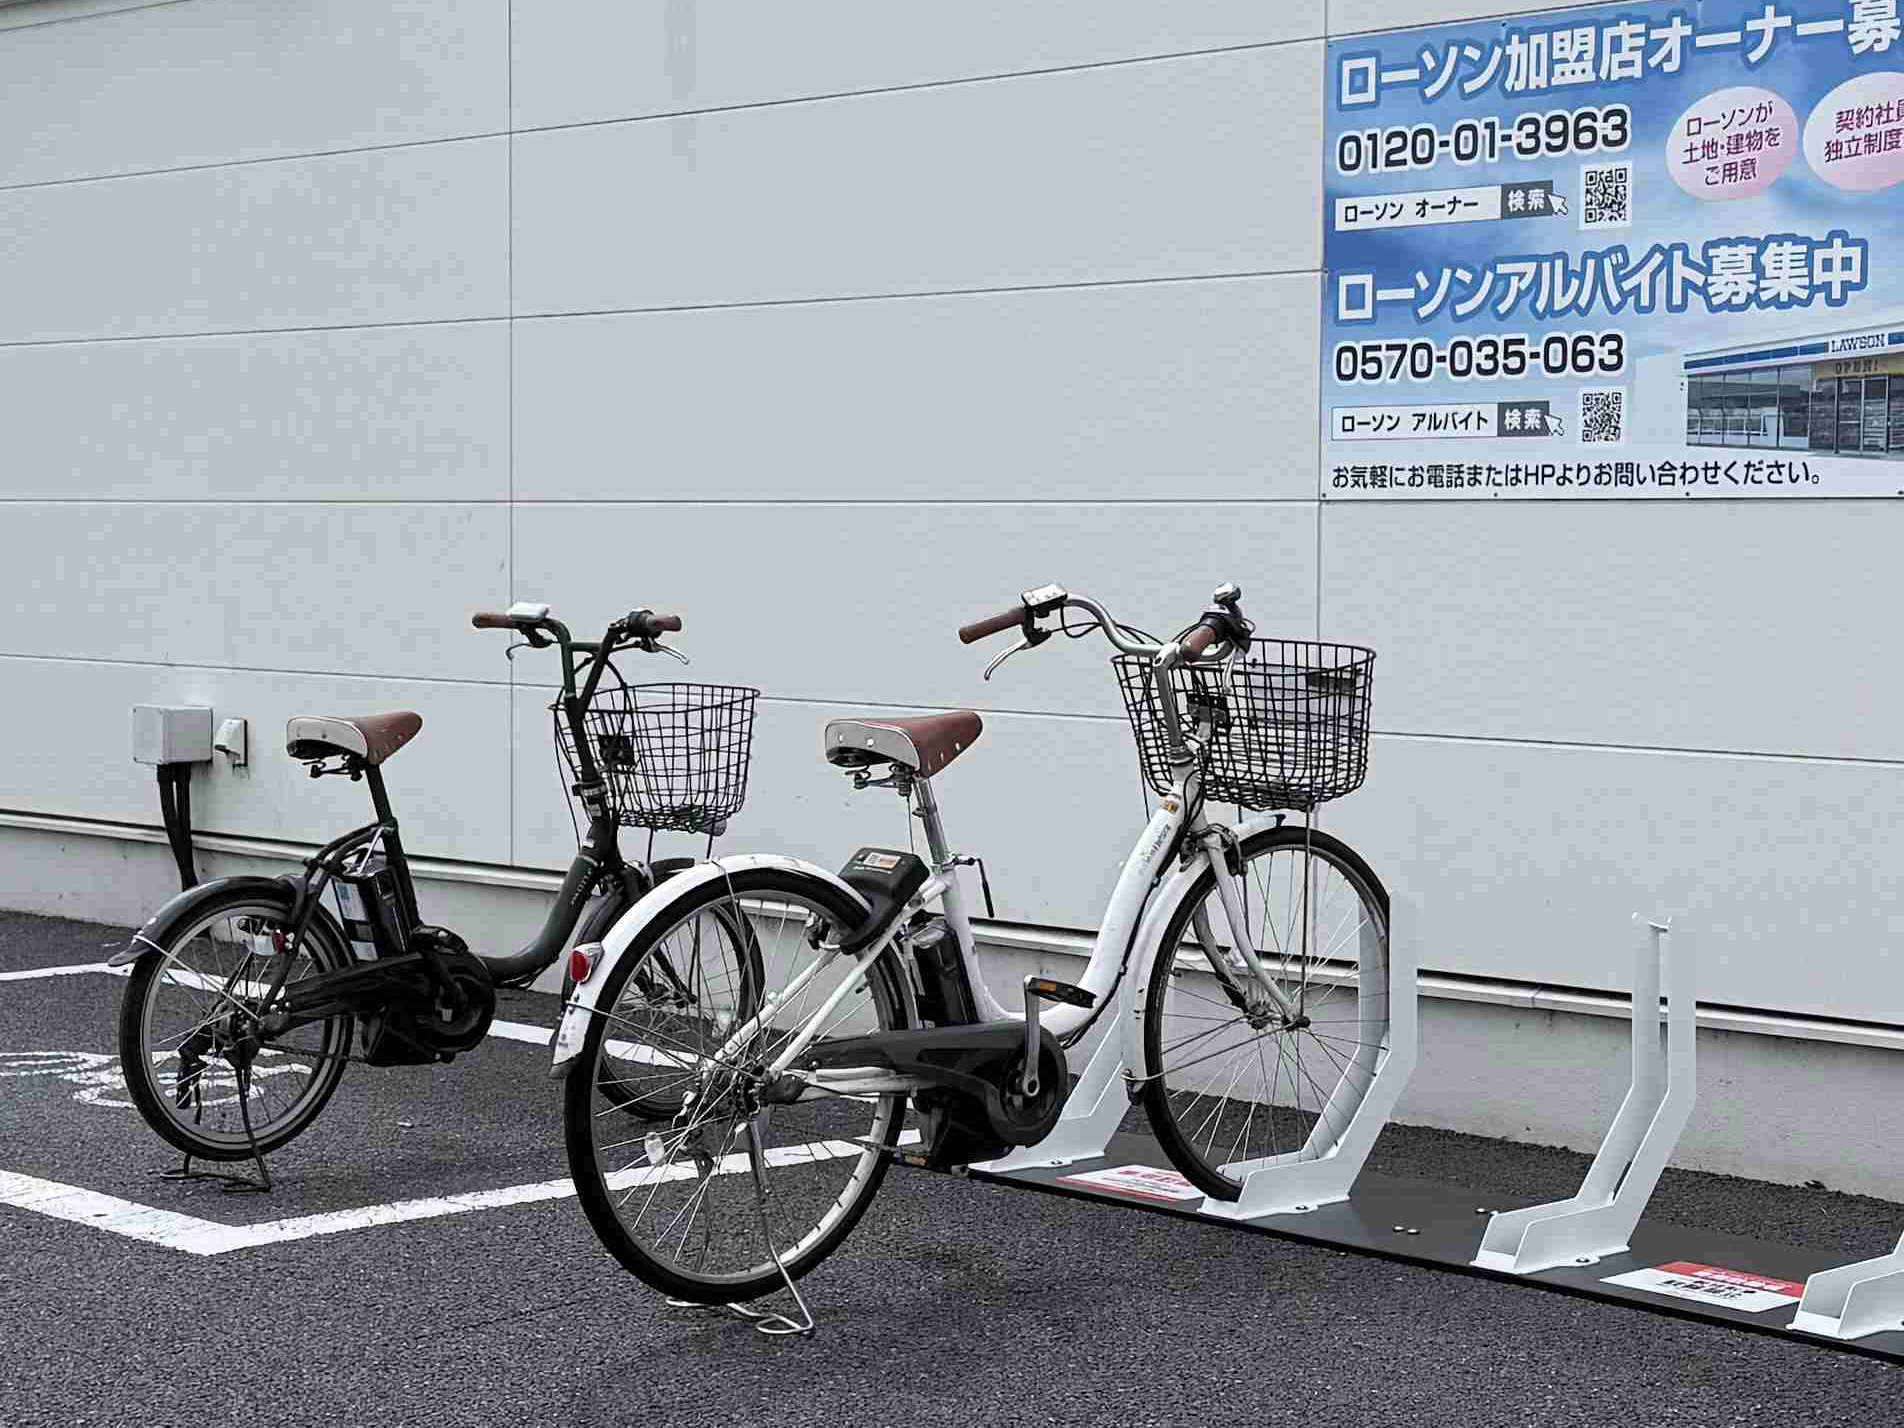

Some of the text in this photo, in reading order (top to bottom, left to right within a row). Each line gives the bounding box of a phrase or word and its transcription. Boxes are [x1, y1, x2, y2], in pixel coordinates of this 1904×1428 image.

[1686, 100, 1775, 136] ローソンが
[1339, 107, 1628, 172] 0120-01-3963
[1682, 127, 1781, 165] 土地・建物を
[1704, 157, 1759, 187] ご用意
[1345, 186, 1546, 222] ローソン オーナー 検索
[1338, 238, 1863, 321] ローソンアルバイト募集中
[1335, 333, 1624, 382] 0570-035-063
[1830, 333, 1886, 354] LAWSON
[1341, 408, 1543, 433] ローソン アルバイト 検索
[1332, 460, 1820, 490] お気軽にお電話またはHPよりお問い合わせください。
